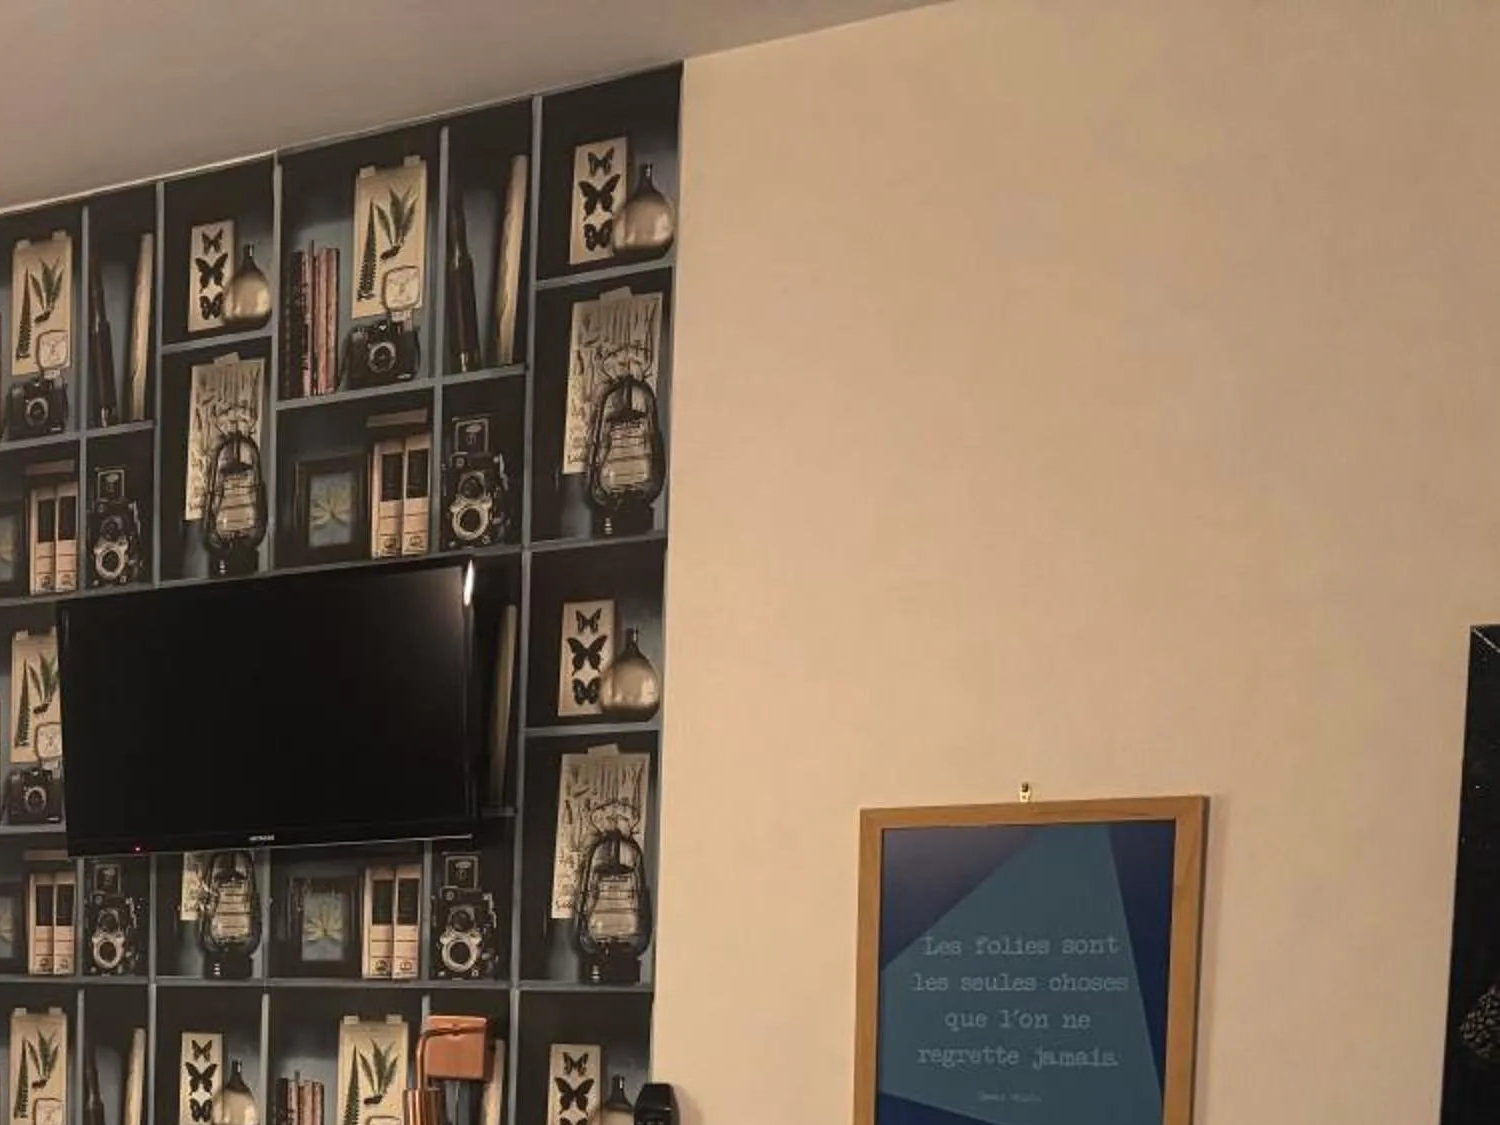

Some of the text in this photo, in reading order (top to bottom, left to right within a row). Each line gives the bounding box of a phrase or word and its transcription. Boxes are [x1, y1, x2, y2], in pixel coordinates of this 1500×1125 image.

[921, 935, 1120, 956] Les folies sont
[912, 972, 1129, 992] les seules choses
[944, 1009, 1092, 1032] que l'on ne
[916, 1047, 1020, 1069] regrette
